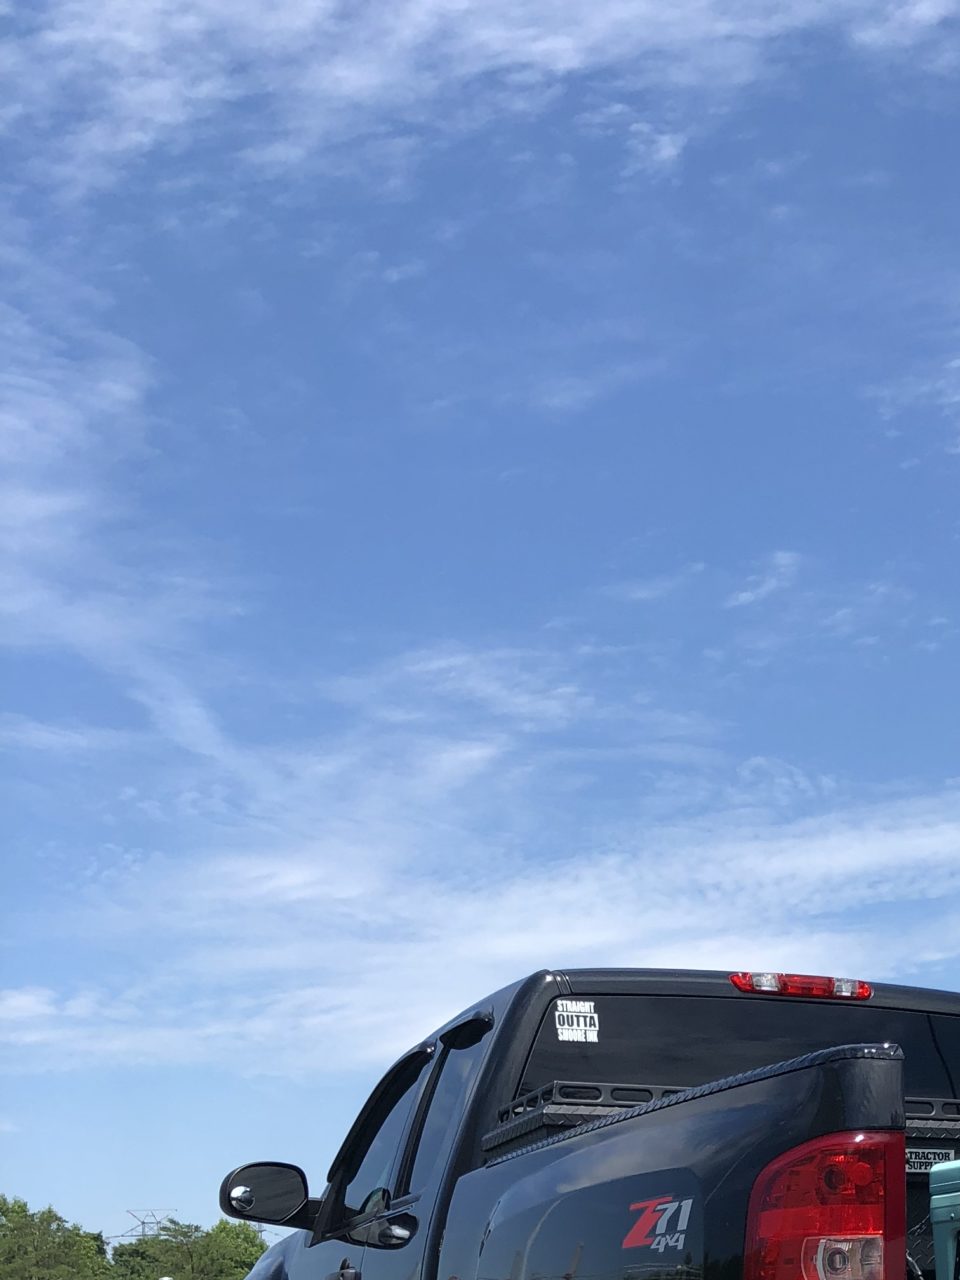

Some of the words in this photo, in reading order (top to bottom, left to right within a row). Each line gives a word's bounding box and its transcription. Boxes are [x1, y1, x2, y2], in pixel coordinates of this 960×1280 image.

[556, 1000, 595, 1013] STRAIGHT
[557, 1013, 597, 1028] OUTTA
[908, 1151, 951, 1161] TRACTOR
[622, 1196, 693, 1249] Z71
